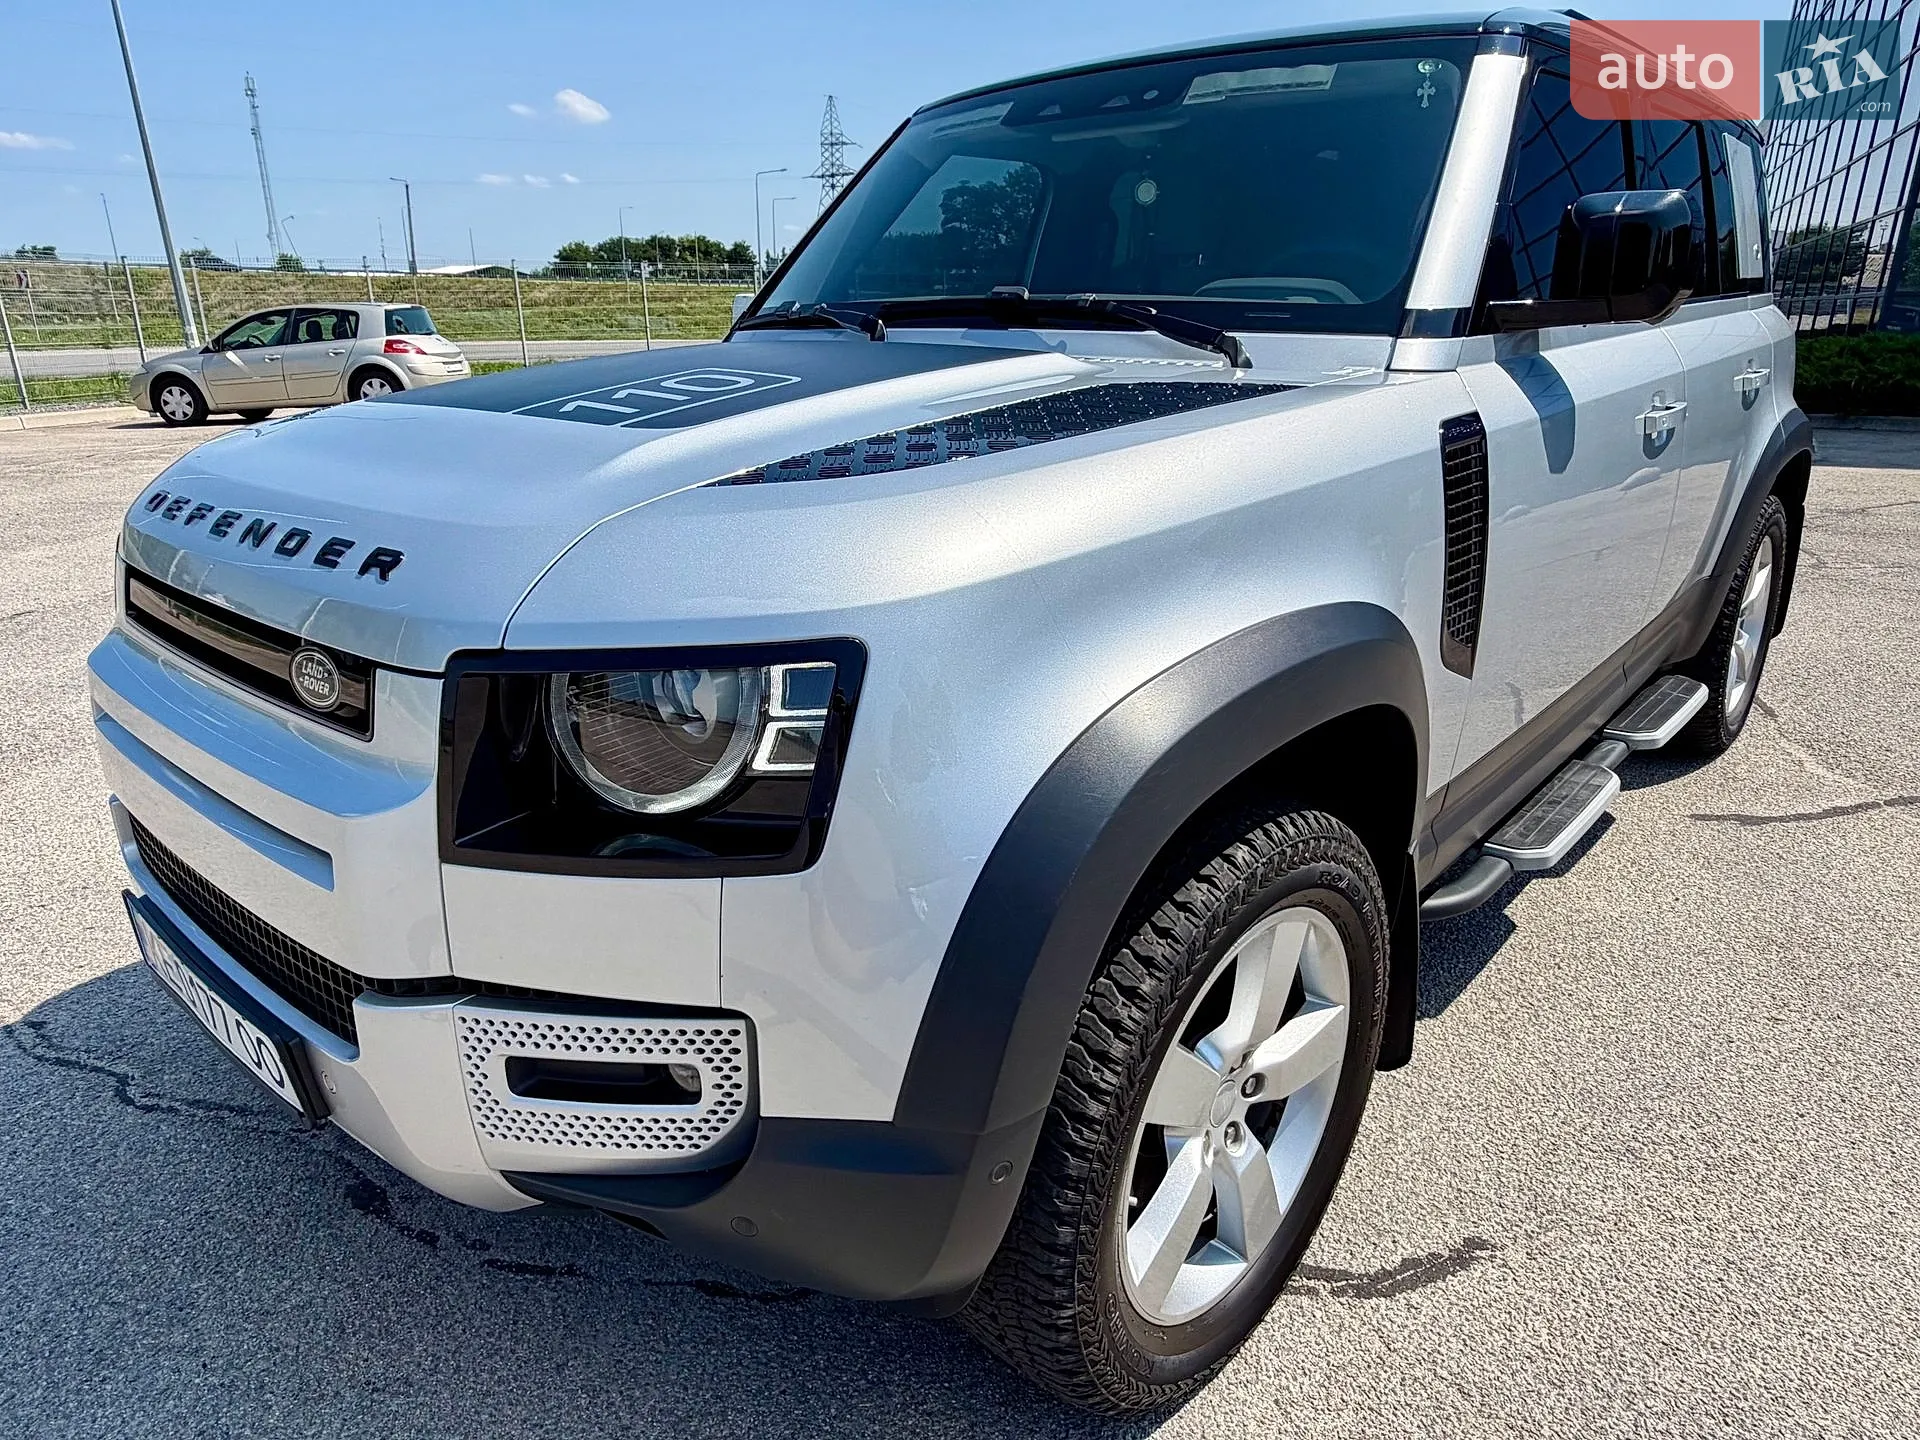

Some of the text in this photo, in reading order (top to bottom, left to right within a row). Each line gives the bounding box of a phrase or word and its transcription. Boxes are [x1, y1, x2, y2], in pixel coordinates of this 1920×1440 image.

[559, 375, 755, 413] 110
[144, 490, 405, 582] DEFENDER
[304, 676, 330, 696] ROVER
